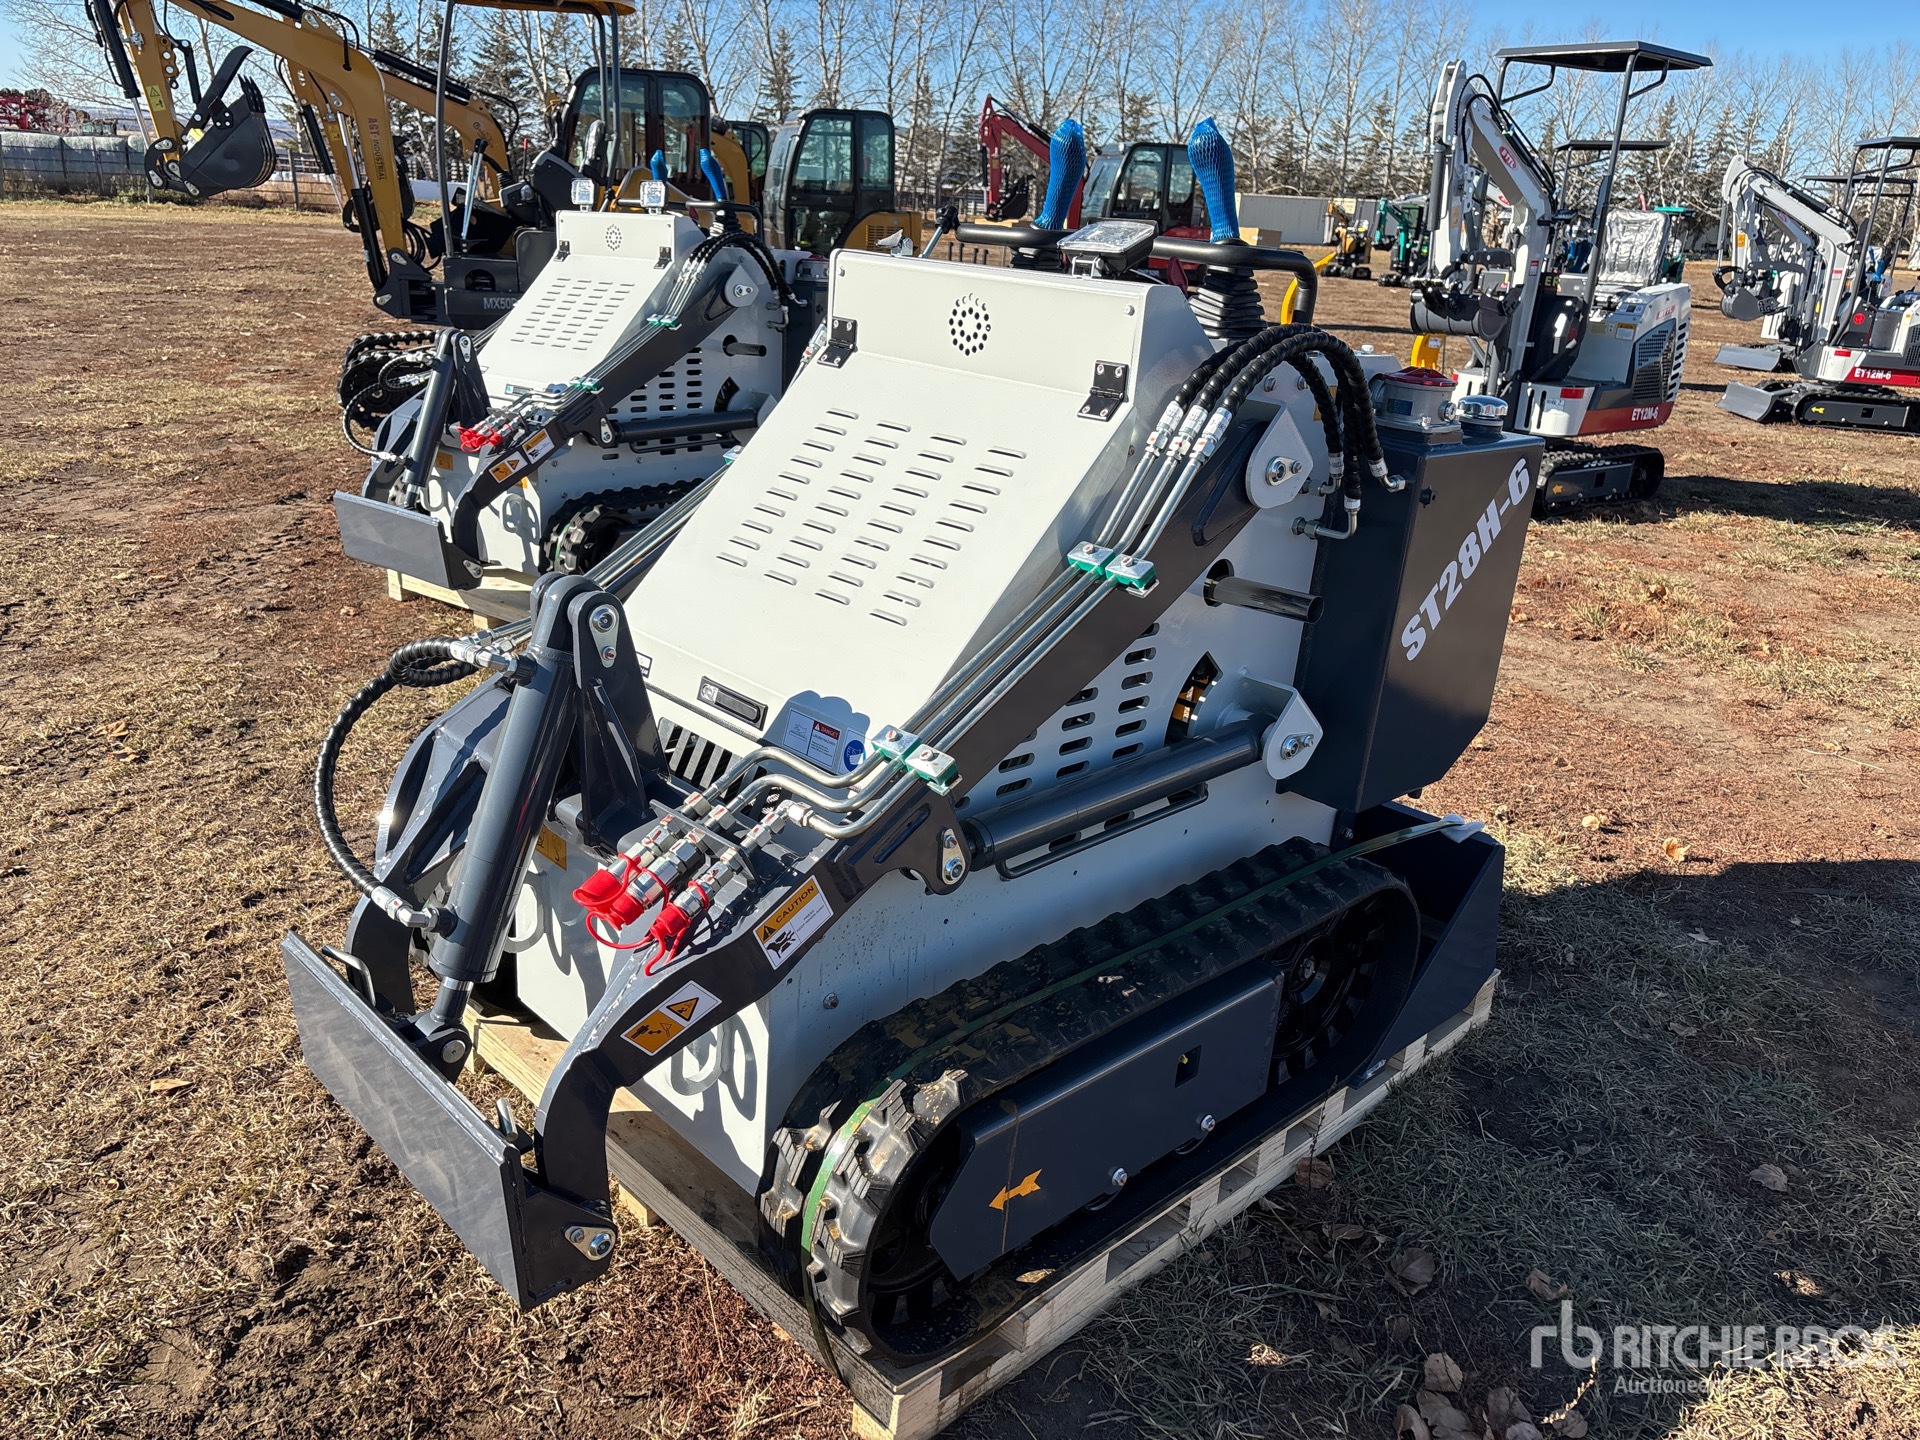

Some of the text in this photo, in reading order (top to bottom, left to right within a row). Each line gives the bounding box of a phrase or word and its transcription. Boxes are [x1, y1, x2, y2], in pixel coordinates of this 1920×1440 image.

[1854, 368, 1892, 380] ET12M-6
[1631, 407, 1659, 422] ET12M-6
[1401, 457, 1531, 662] ST28H-6
[775, 885, 815, 923] CAUTION
